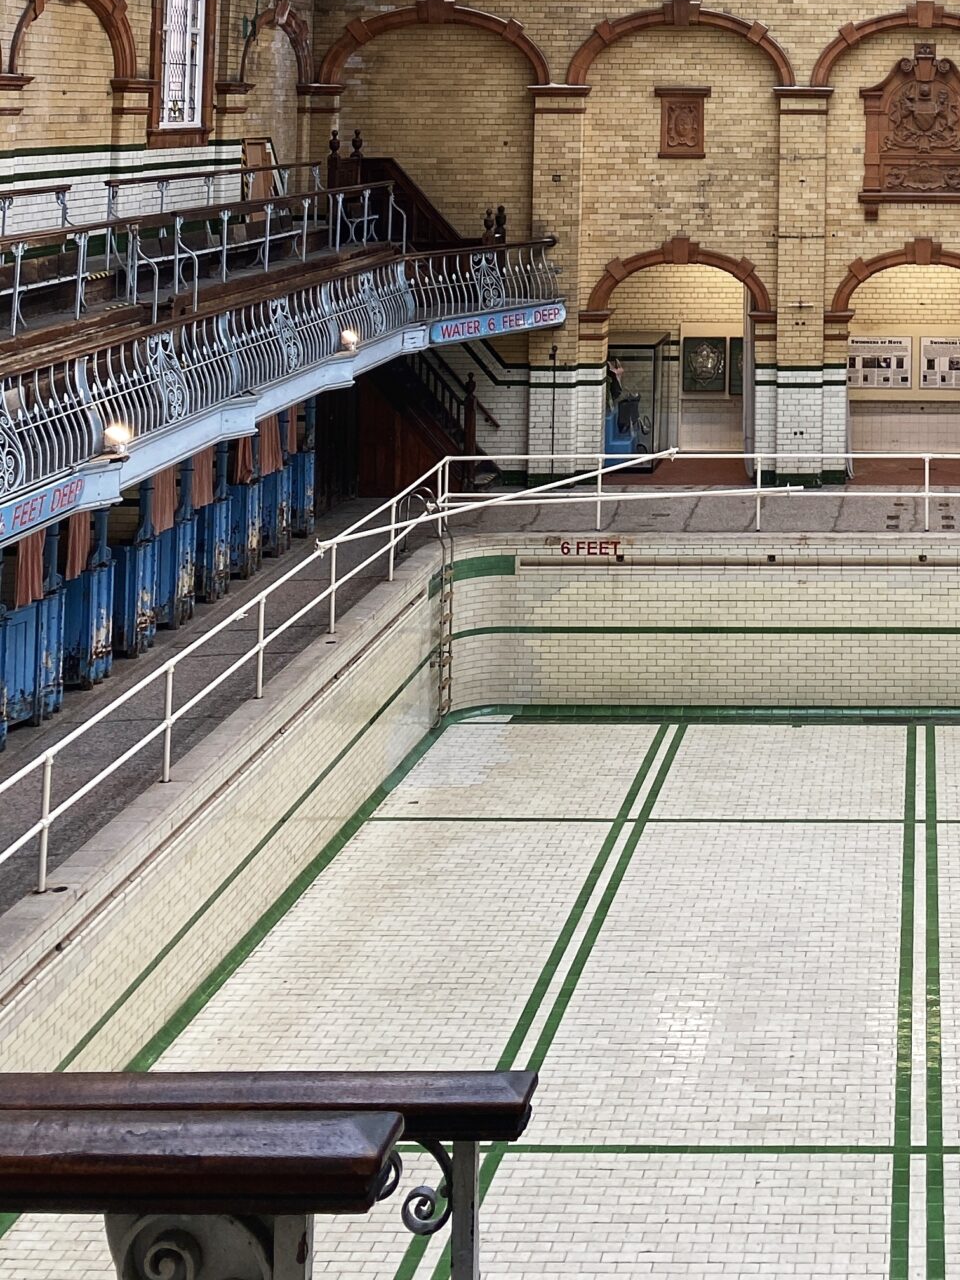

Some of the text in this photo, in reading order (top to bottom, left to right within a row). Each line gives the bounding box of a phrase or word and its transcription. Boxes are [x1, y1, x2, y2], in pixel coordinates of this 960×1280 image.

[440, 307, 560, 339] WATER 6 FEET DEEP
[11, 494, 47, 530] FEET
[50, 479, 83, 513] DEEP
[561, 541, 621, 556] 6 FEET
